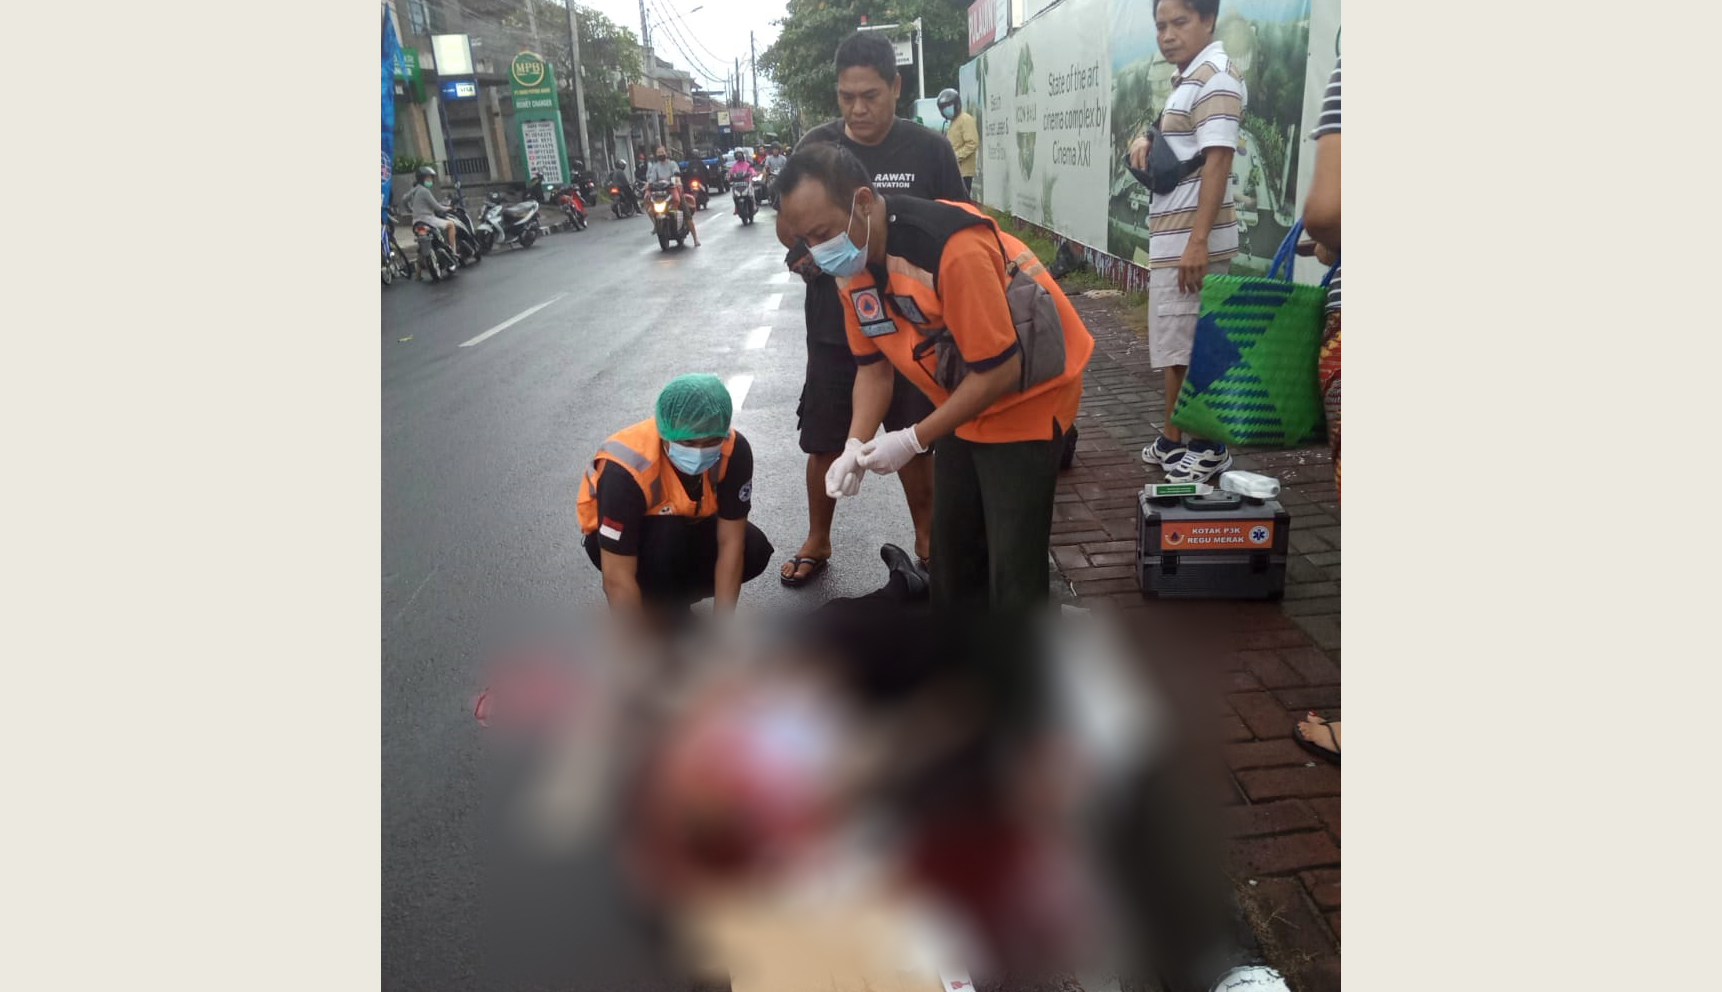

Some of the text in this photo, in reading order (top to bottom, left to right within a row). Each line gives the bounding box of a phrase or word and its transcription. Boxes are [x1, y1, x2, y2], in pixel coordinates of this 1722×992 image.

[516, 62, 541, 74] MPB
[1048, 60, 1099, 97] State of the art
[1043, 98, 1107, 137] cinema complex by
[1052, 140, 1091, 167] Cinema XXI
[874, 173, 915, 182] RAWATI
